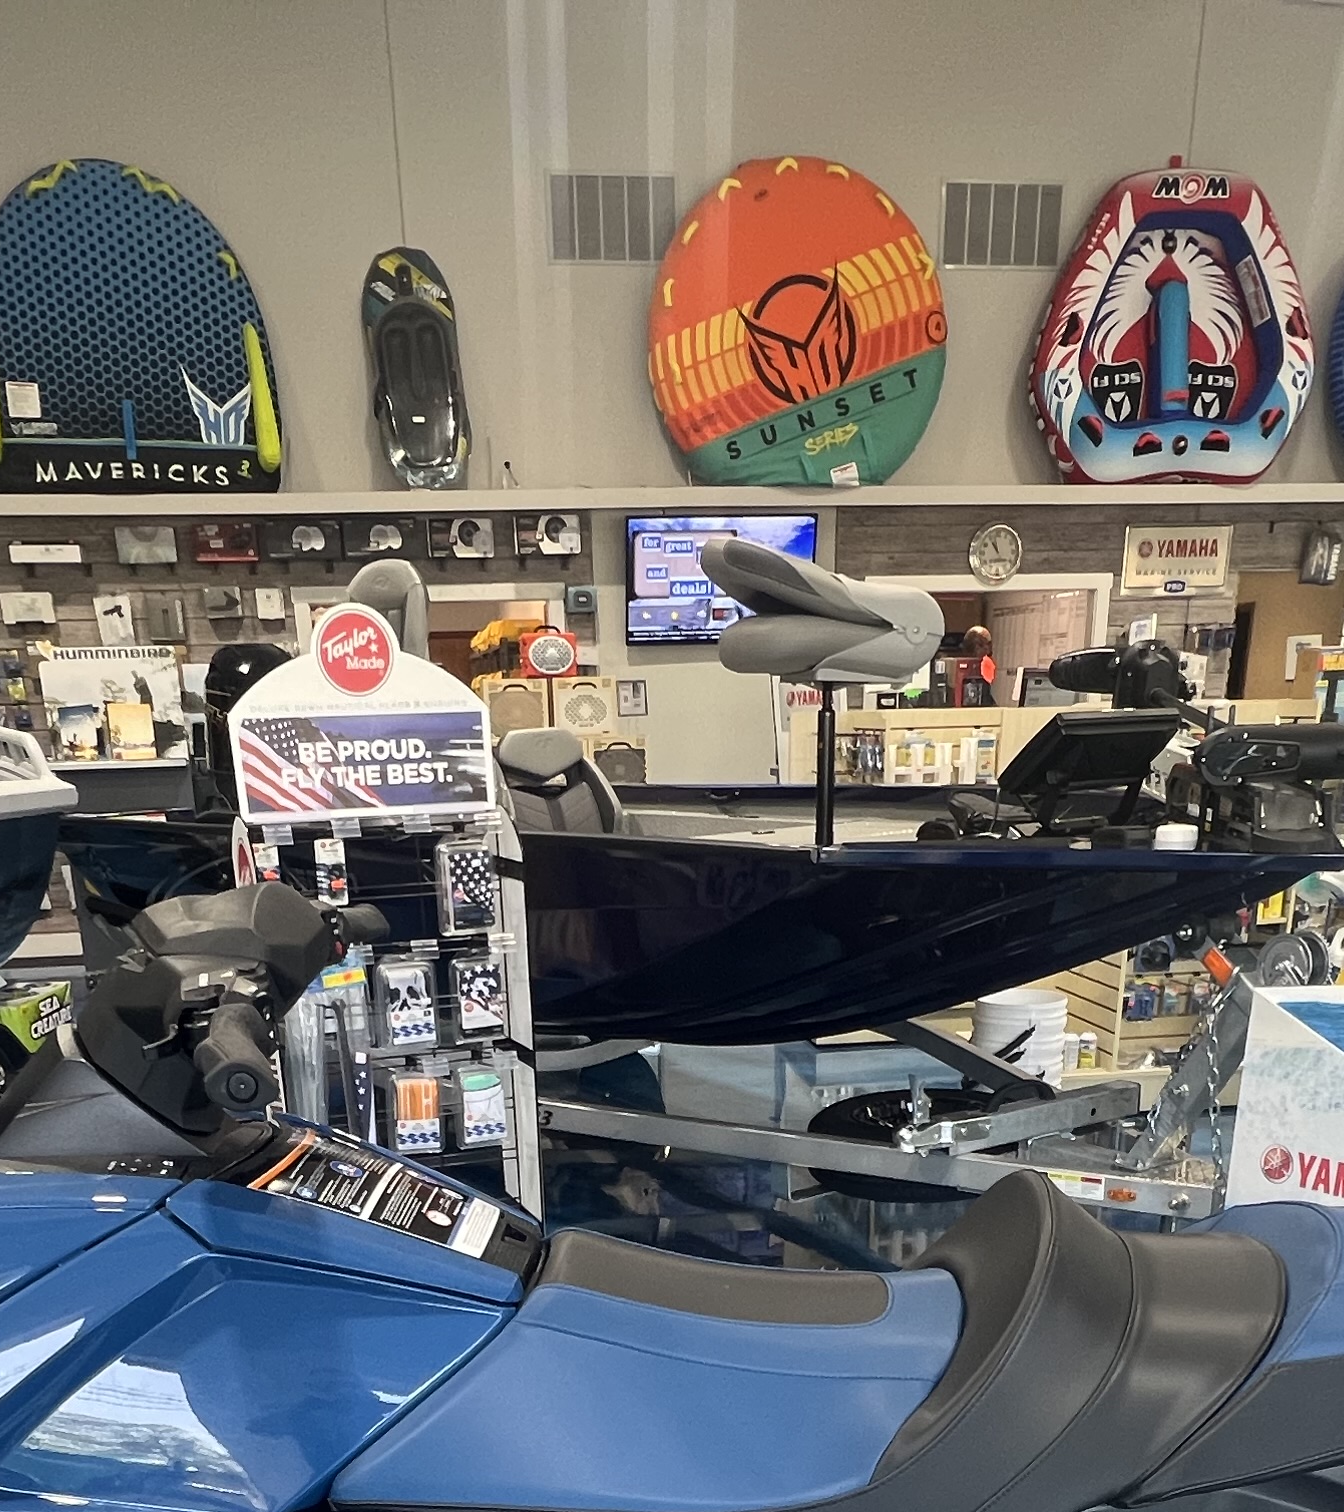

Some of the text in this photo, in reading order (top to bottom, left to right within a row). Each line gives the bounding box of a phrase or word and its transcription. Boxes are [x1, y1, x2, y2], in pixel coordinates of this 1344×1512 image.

[726, 367, 918, 460] SUNSET
[35, 459, 230, 486] MAVERICKS
[643, 538, 692, 554] for great
[1157, 538, 1219, 558] YAMAHA
[647, 568, 667, 578] and
[672, 581, 712, 595] deals!
[323, 626, 378, 663] Taylor
[345, 656, 386, 670] Made
[298, 738, 432, 764] BE PROUD.
[282, 762, 454, 789] FLY THE BEST.
[39, 996, 61, 1017] SEA
